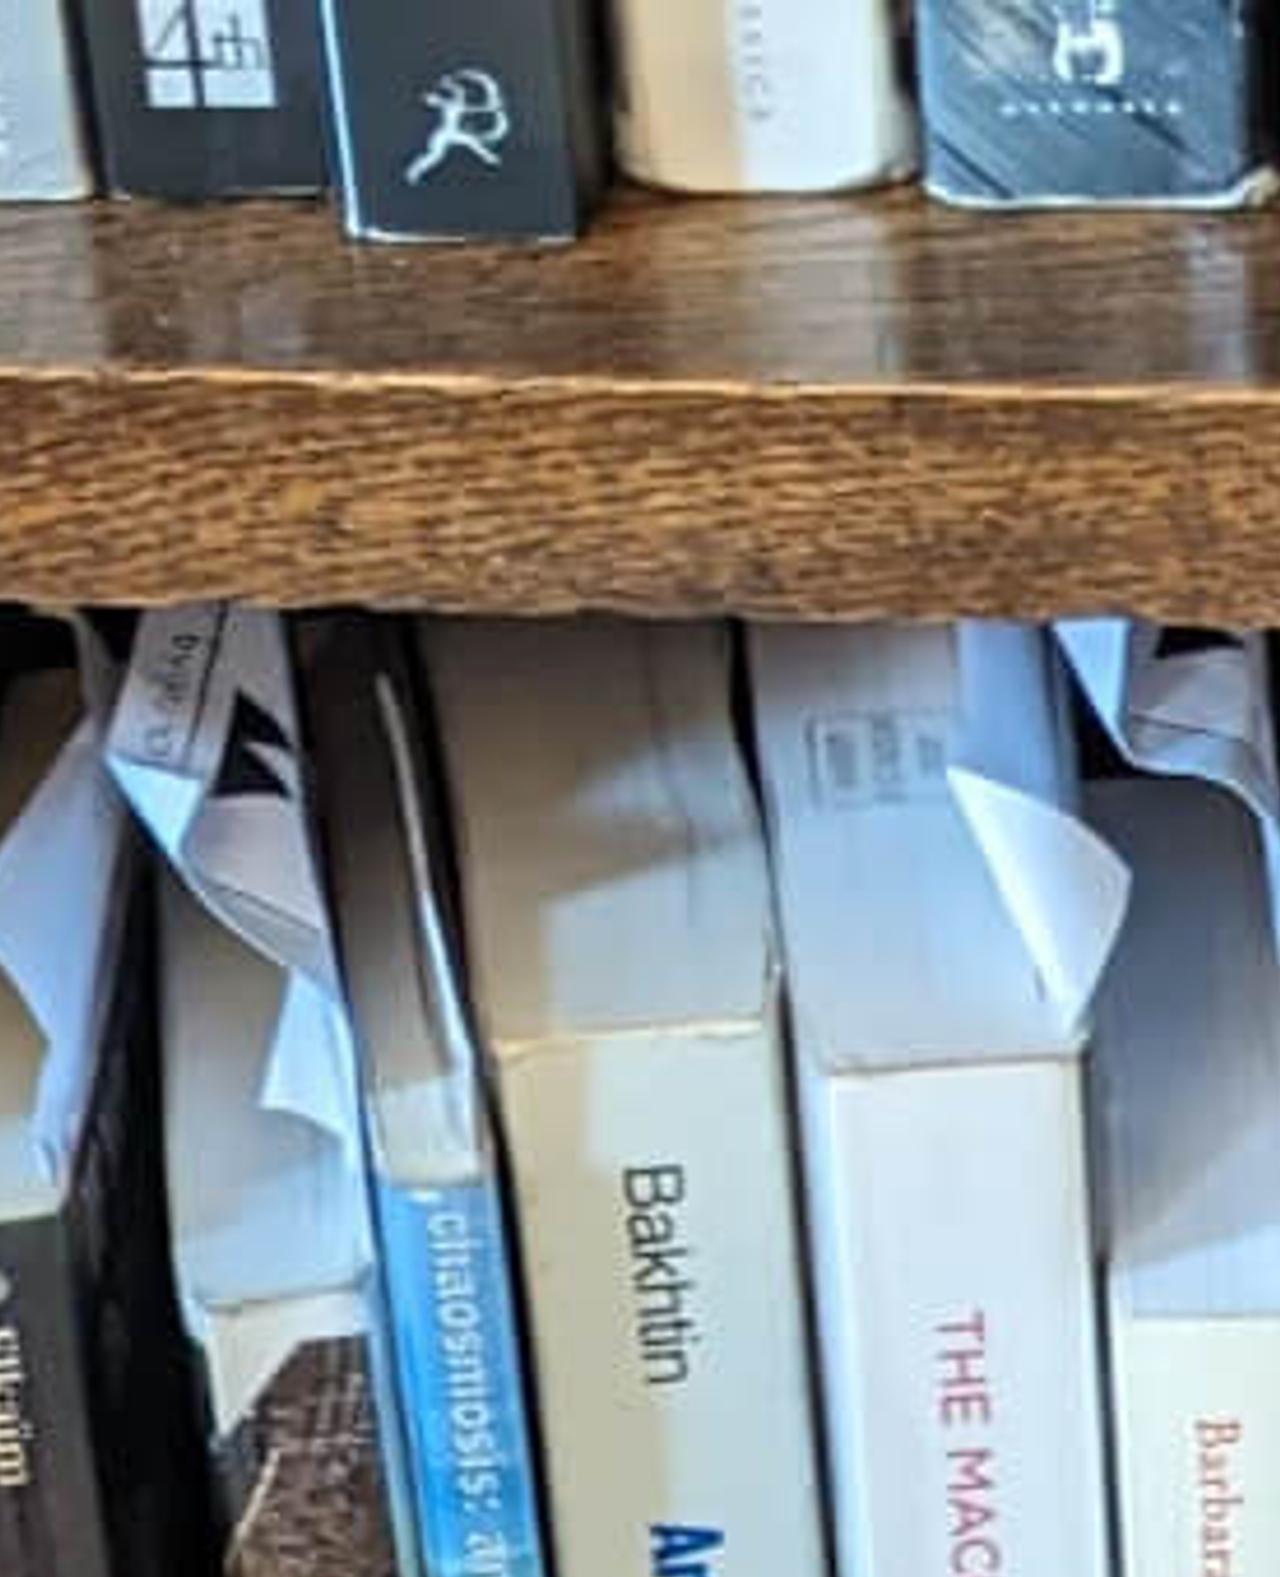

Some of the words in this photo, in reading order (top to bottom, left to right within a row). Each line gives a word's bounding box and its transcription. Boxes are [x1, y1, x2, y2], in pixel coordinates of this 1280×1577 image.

[421, 1209, 504, 1514] chaosmosis:
[620, 1161, 696, 1387] Bakhtin
[932, 1310, 995, 1427] THE
